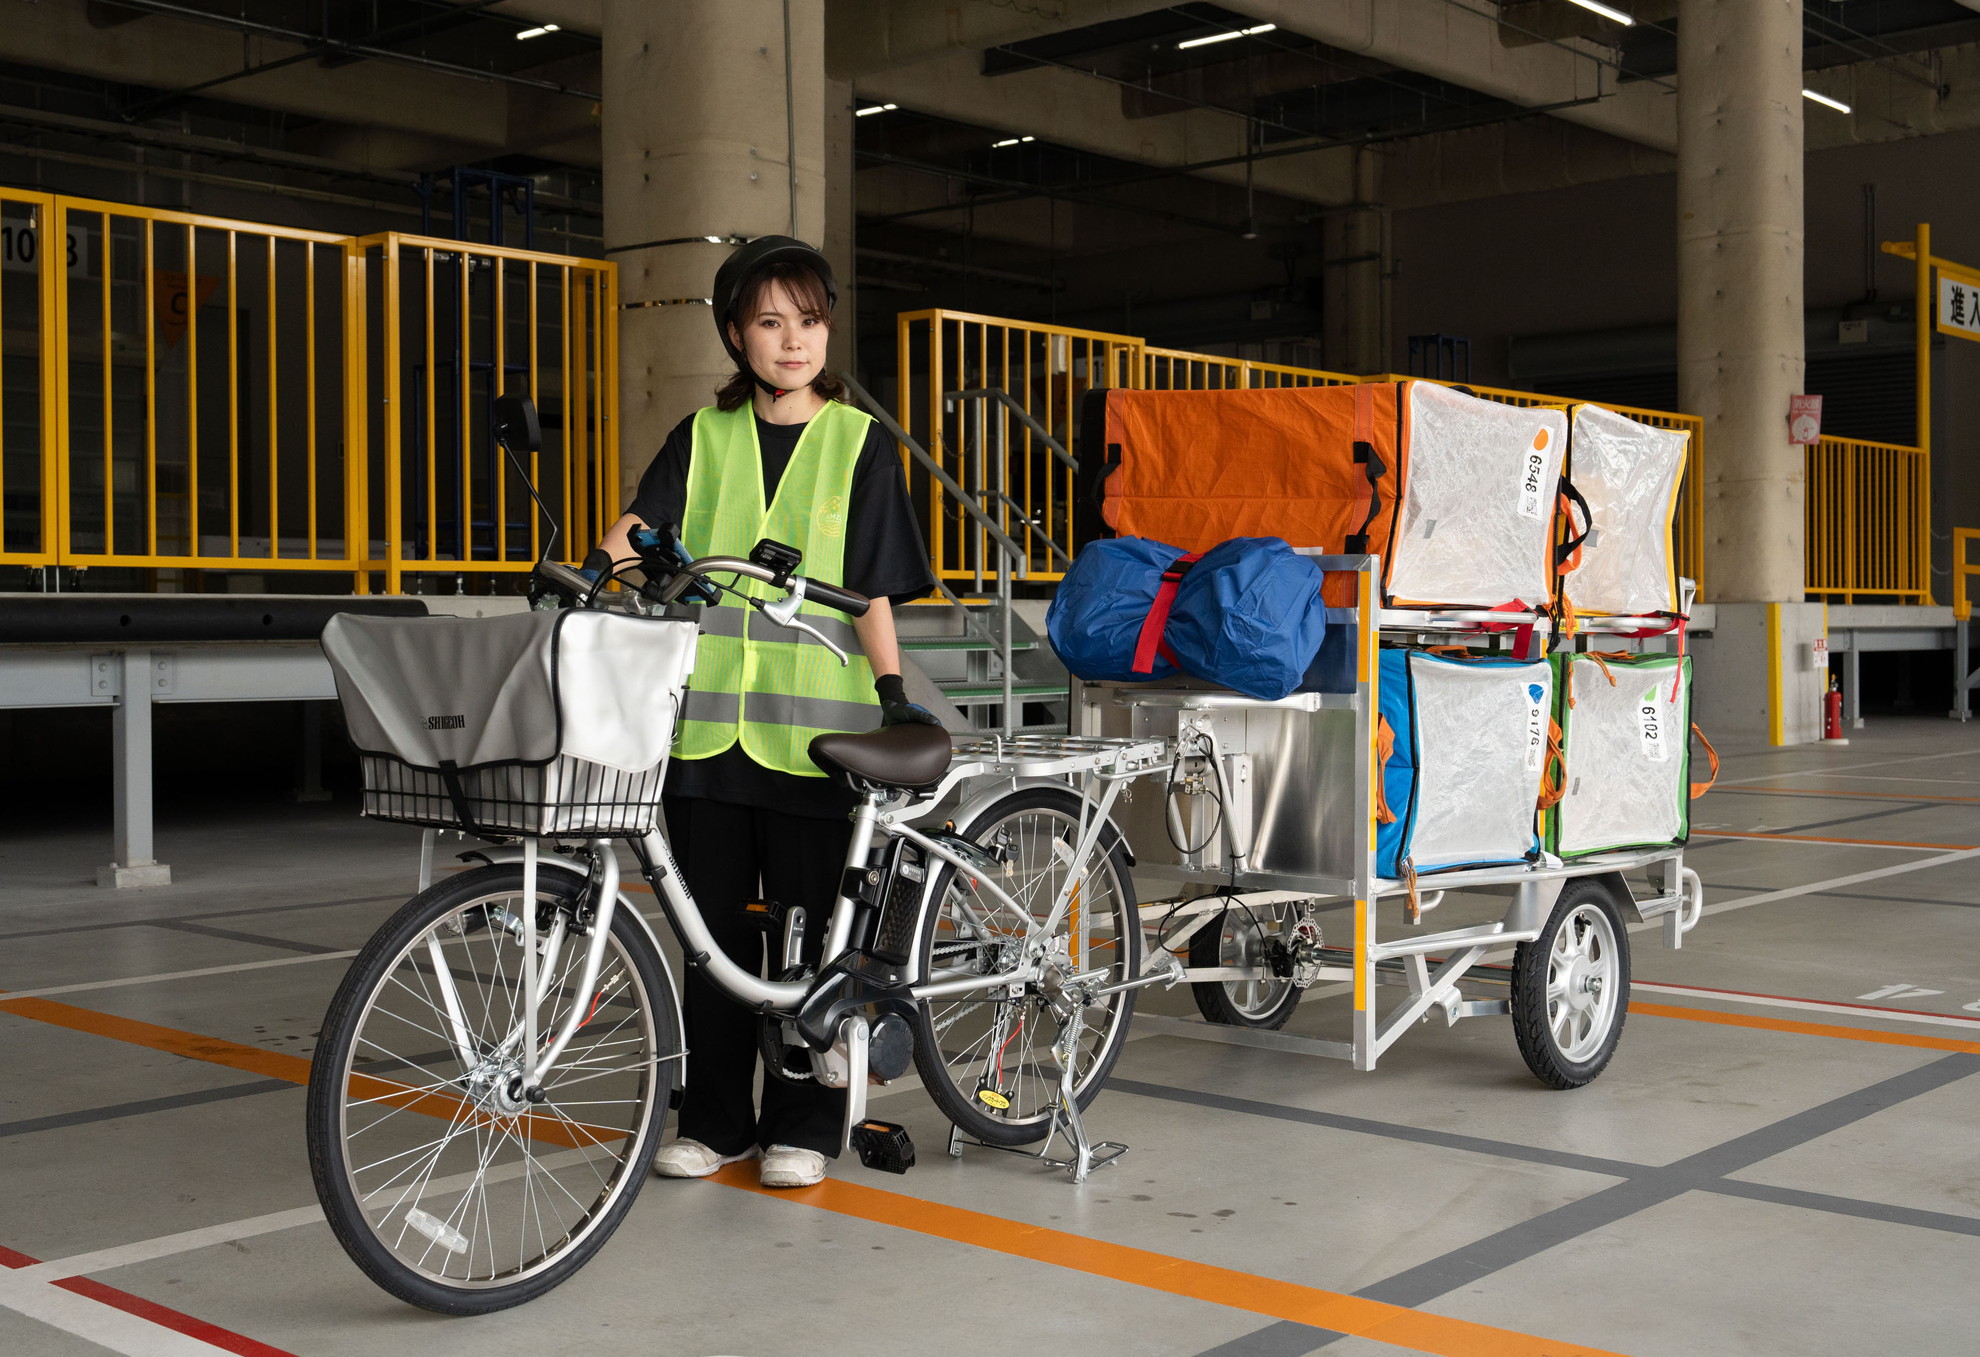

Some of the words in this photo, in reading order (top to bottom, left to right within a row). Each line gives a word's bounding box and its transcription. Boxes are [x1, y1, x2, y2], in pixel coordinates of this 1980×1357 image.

[1525, 454, 1542, 493] 6548
[1531, 708, 1540, 746] 9176
[1642, 706, 1658, 740] 6102
